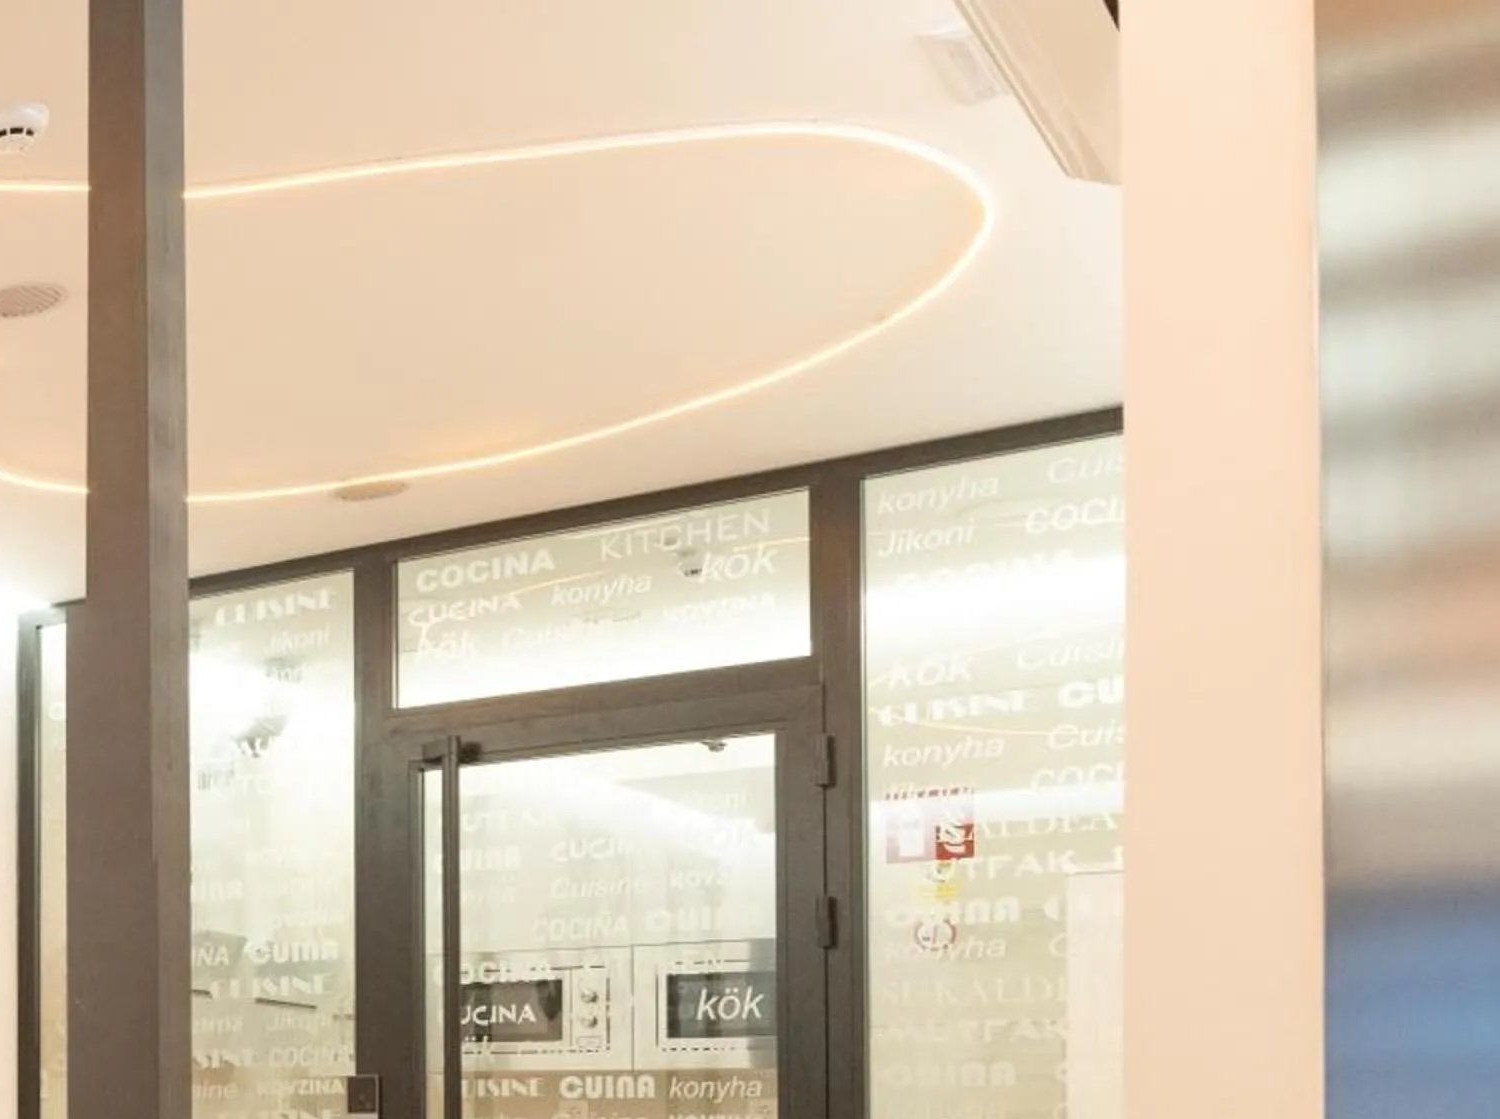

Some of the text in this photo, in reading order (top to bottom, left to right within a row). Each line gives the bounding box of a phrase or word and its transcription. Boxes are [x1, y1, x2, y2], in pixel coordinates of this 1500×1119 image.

[876, 475, 1000, 516] konyha
[416, 508, 772, 593] COCINA KITCHEN
[876, 516, 978, 558] Jikoni
[550, 572, 653, 608] konyha
[882, 733, 1006, 770] konyha
[696, 985, 766, 1021] kök
[559, 1075, 656, 1099] CUINA
[668, 1076, 763, 1104] konyha
